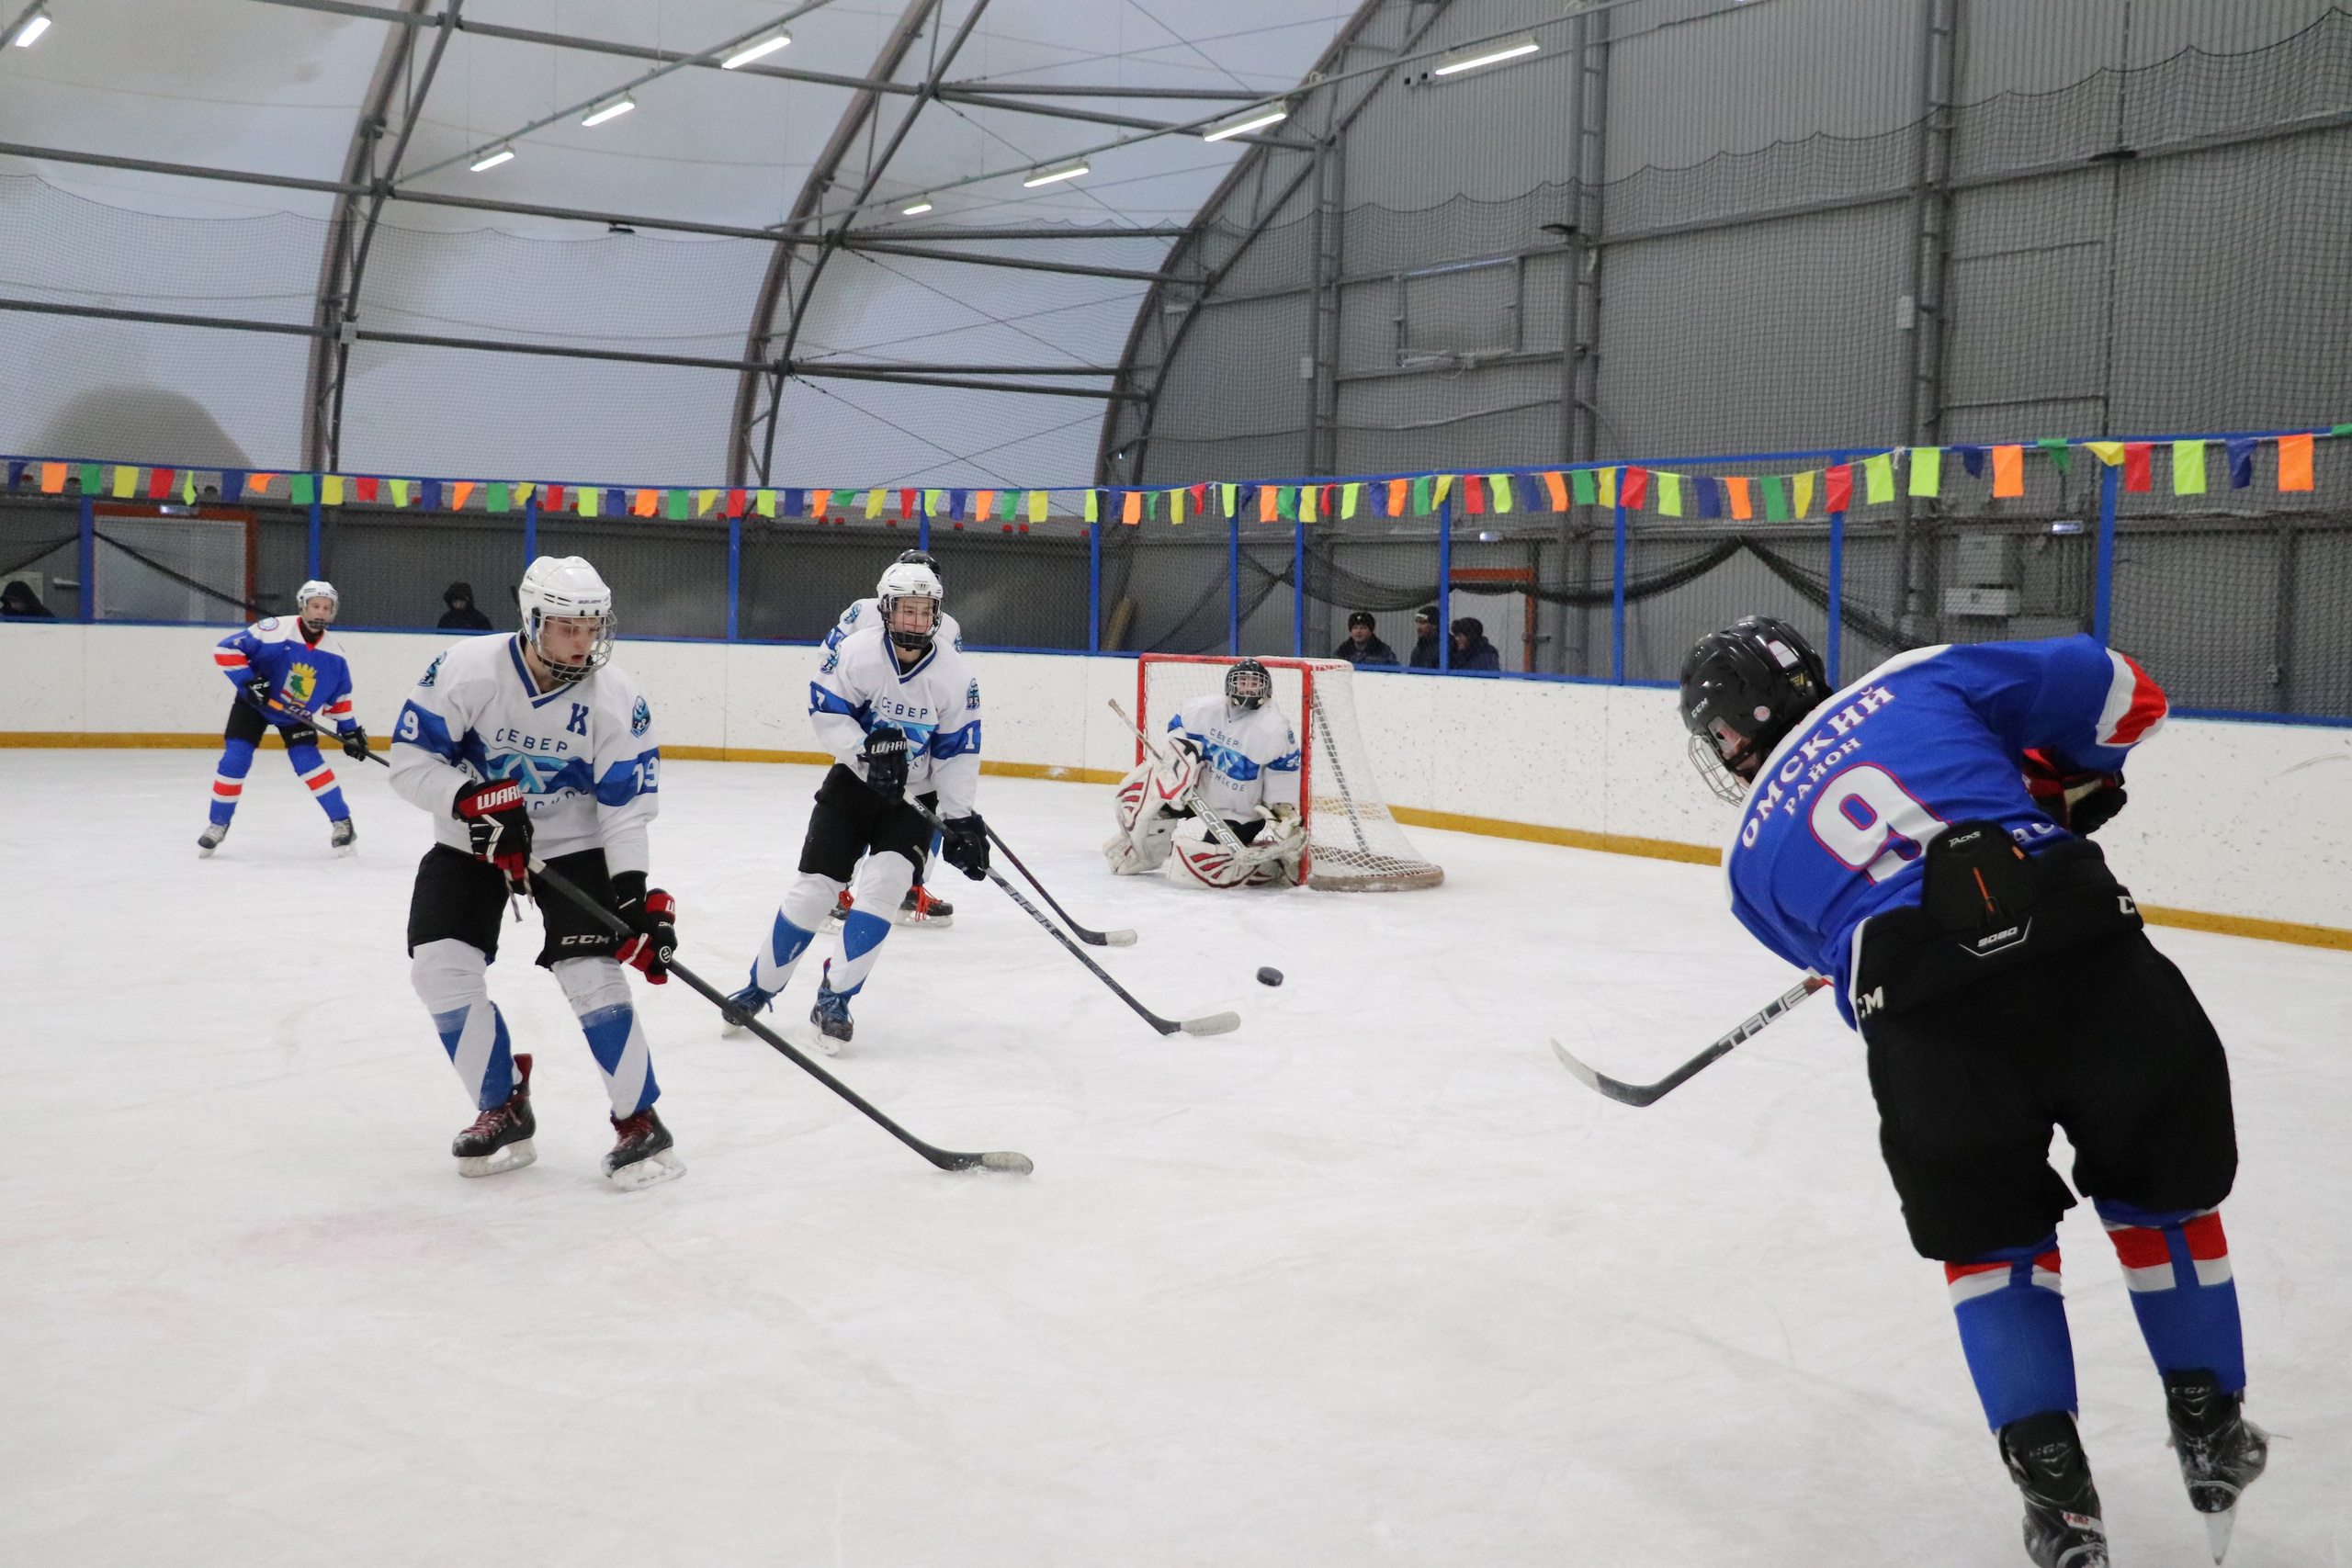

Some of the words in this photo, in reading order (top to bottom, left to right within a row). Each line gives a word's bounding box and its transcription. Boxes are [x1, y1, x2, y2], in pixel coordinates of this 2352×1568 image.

[1690, 697, 1709, 718] CCM
[495, 728, 569, 753] СЕВЕР
[1742, 686, 1895, 848] ОМСКИЙ
[1782, 737, 1862, 816] РАЙОН
[1949, 830, 1981, 848] TACKS
[561, 934, 611, 945] CCM
[1977, 926, 2018, 948] 9080
[1718, 982, 1810, 1048] TRUE
